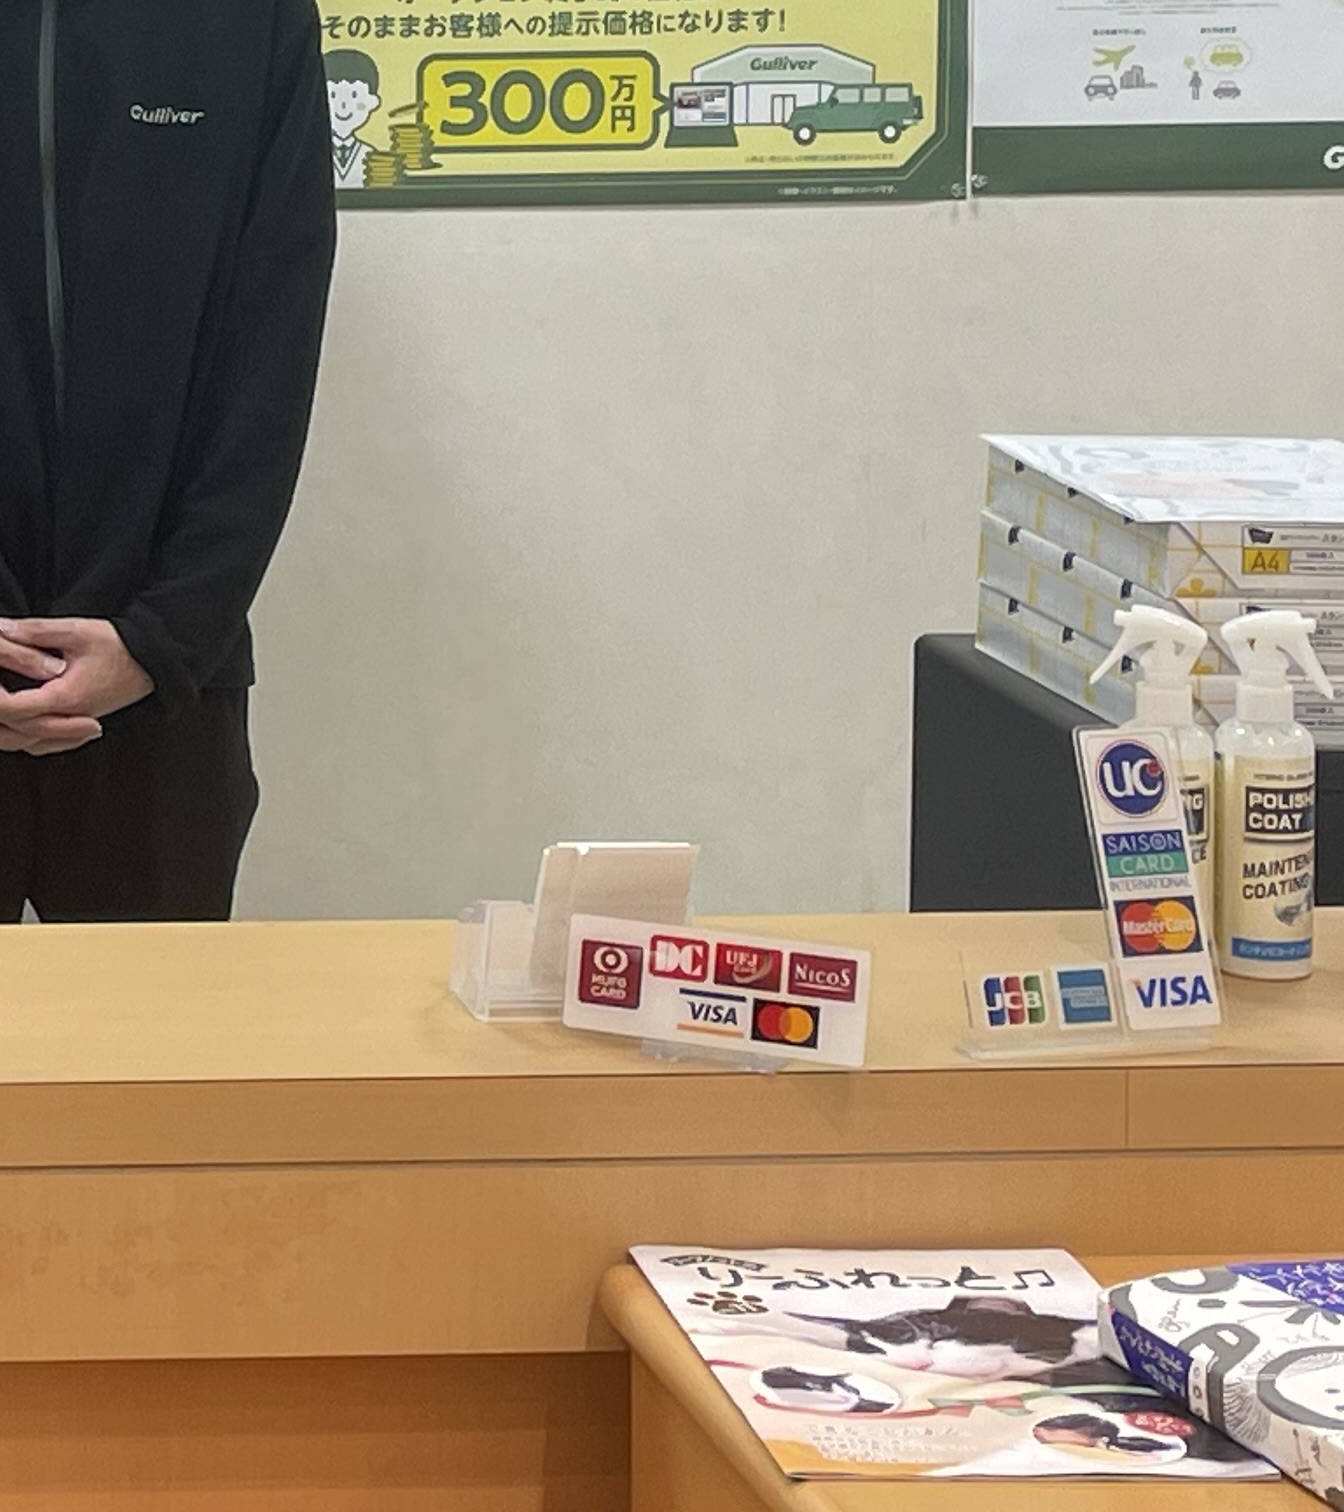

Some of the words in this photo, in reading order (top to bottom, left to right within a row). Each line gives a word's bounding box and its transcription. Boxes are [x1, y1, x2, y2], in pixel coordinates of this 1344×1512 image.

[749, 55, 819, 73] Gulliver
[129, 104, 206, 127] Gulliver
[1250, 548, 1281, 572] A4
[1247, 812, 1303, 830] COAT
[1105, 831, 1183, 855] SAISON
[1118, 854, 1176, 875] CARD
[1108, 876, 1193, 892] INTERNATIONAL
[1121, 913, 1196, 936] MasterCard
[654, 940, 704, 977] DC
[986, 989, 1042, 1012] JCB
[1134, 975, 1213, 1009] VISA
[686, 999, 739, 1027] VISA
